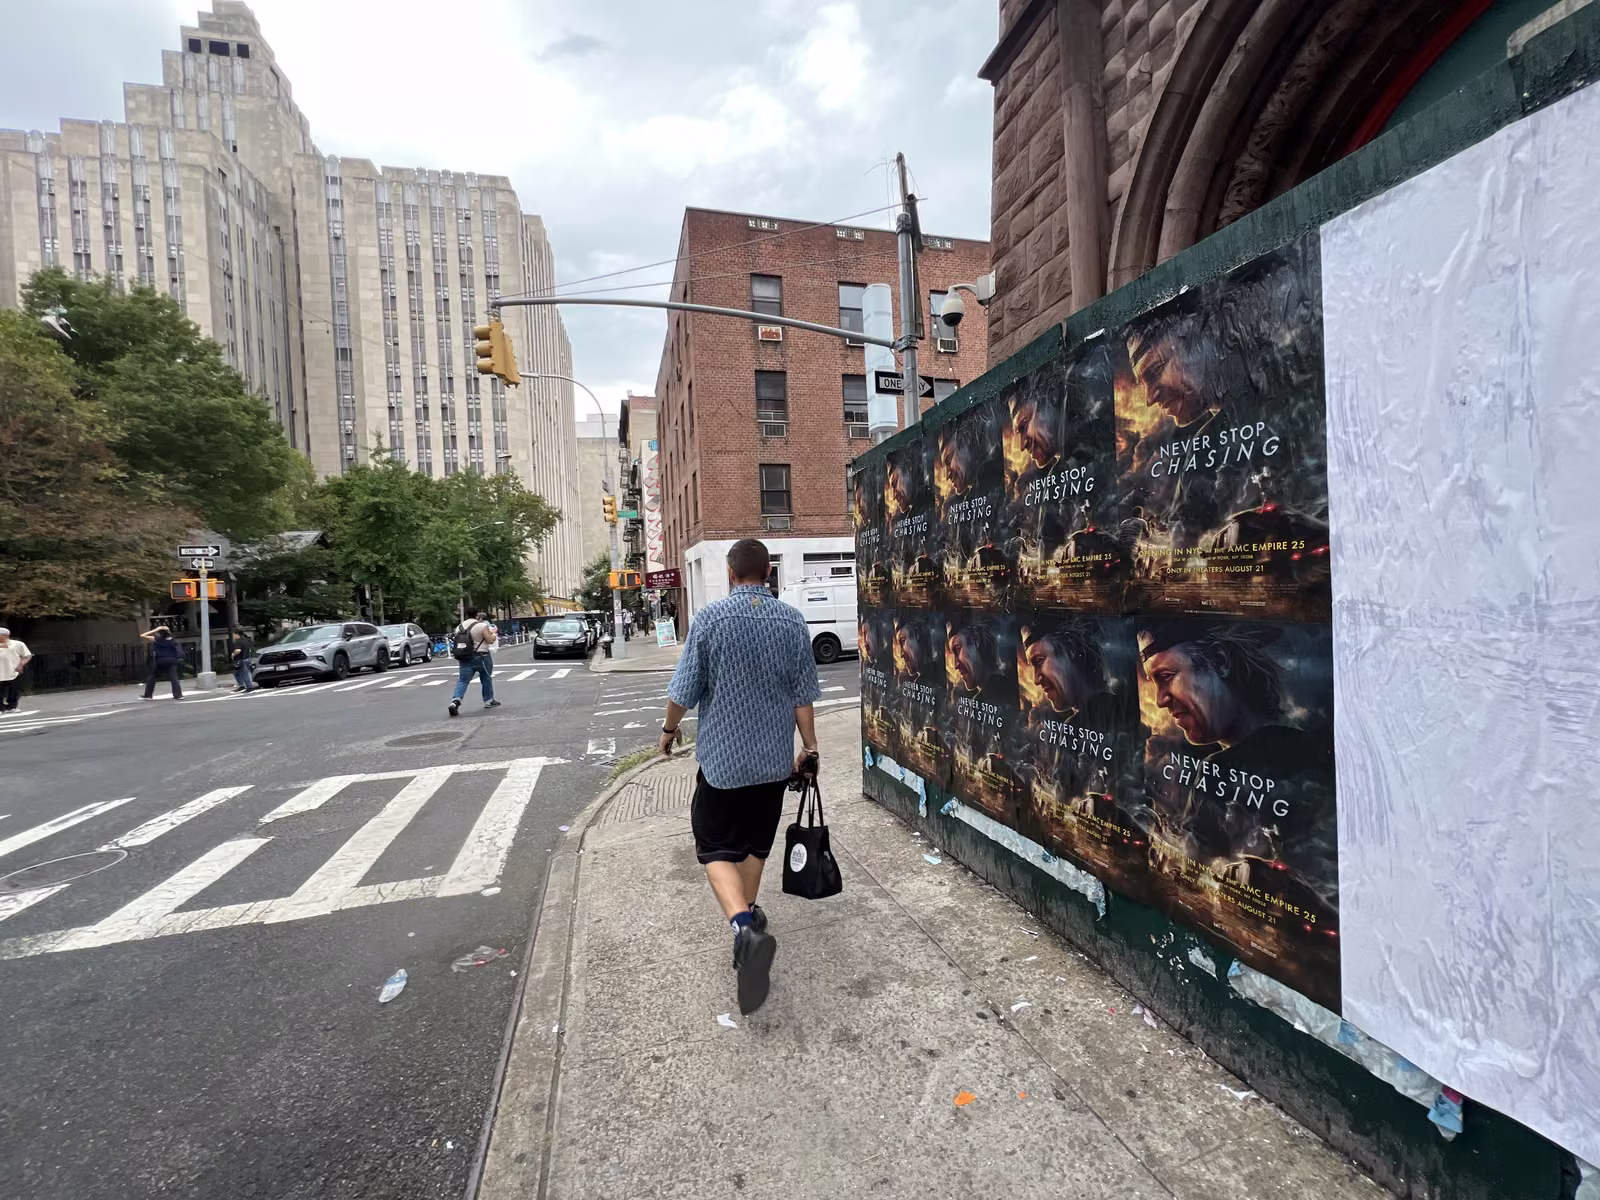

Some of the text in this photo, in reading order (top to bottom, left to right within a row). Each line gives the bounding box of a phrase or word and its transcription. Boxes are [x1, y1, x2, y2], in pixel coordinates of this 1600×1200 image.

[884, 379, 902, 388] ONE
[1160, 422, 1266, 458] NEVER STOP
[1151, 436, 1280, 478] CHASING
[1028, 466, 1086, 492] NEVER STOP
[1025, 477, 1094, 506] CHASING
[948, 505, 991, 525] CHASING
[950, 496, 986, 513] NEVER STOP
[894, 522, 928, 538] CHASING
[1228, 544, 1249, 553] AMC
[1252, 541, 1287, 551] EMPIRE
[1291, 540, 1305, 549] 25
[903, 688, 935, 705] CHASING
[960, 696, 997, 714] NEVER STOP
[958, 705, 1002, 728] CHASING
[1044, 720, 1104, 743] NEVER STOP
[1039, 729, 1112, 761] CHASING
[1171, 752, 1275, 793] NEVER STOP
[1162, 764, 1290, 817] CHASING
[1100, 820, 1121, 833] EMPIRE
[1122, 828, 1131, 837] 25
[1180, 872, 1195, 883] ONLY
[1237, 901, 1266, 918] AUGUST
[1268, 916, 1276, 924] 21
[1188, 857, 1196, 866] IN
[1240, 884, 1261, 897] AMC
[1264, 893, 1300, 915] EMPIRE
[1303, 911, 1316, 923] 25
